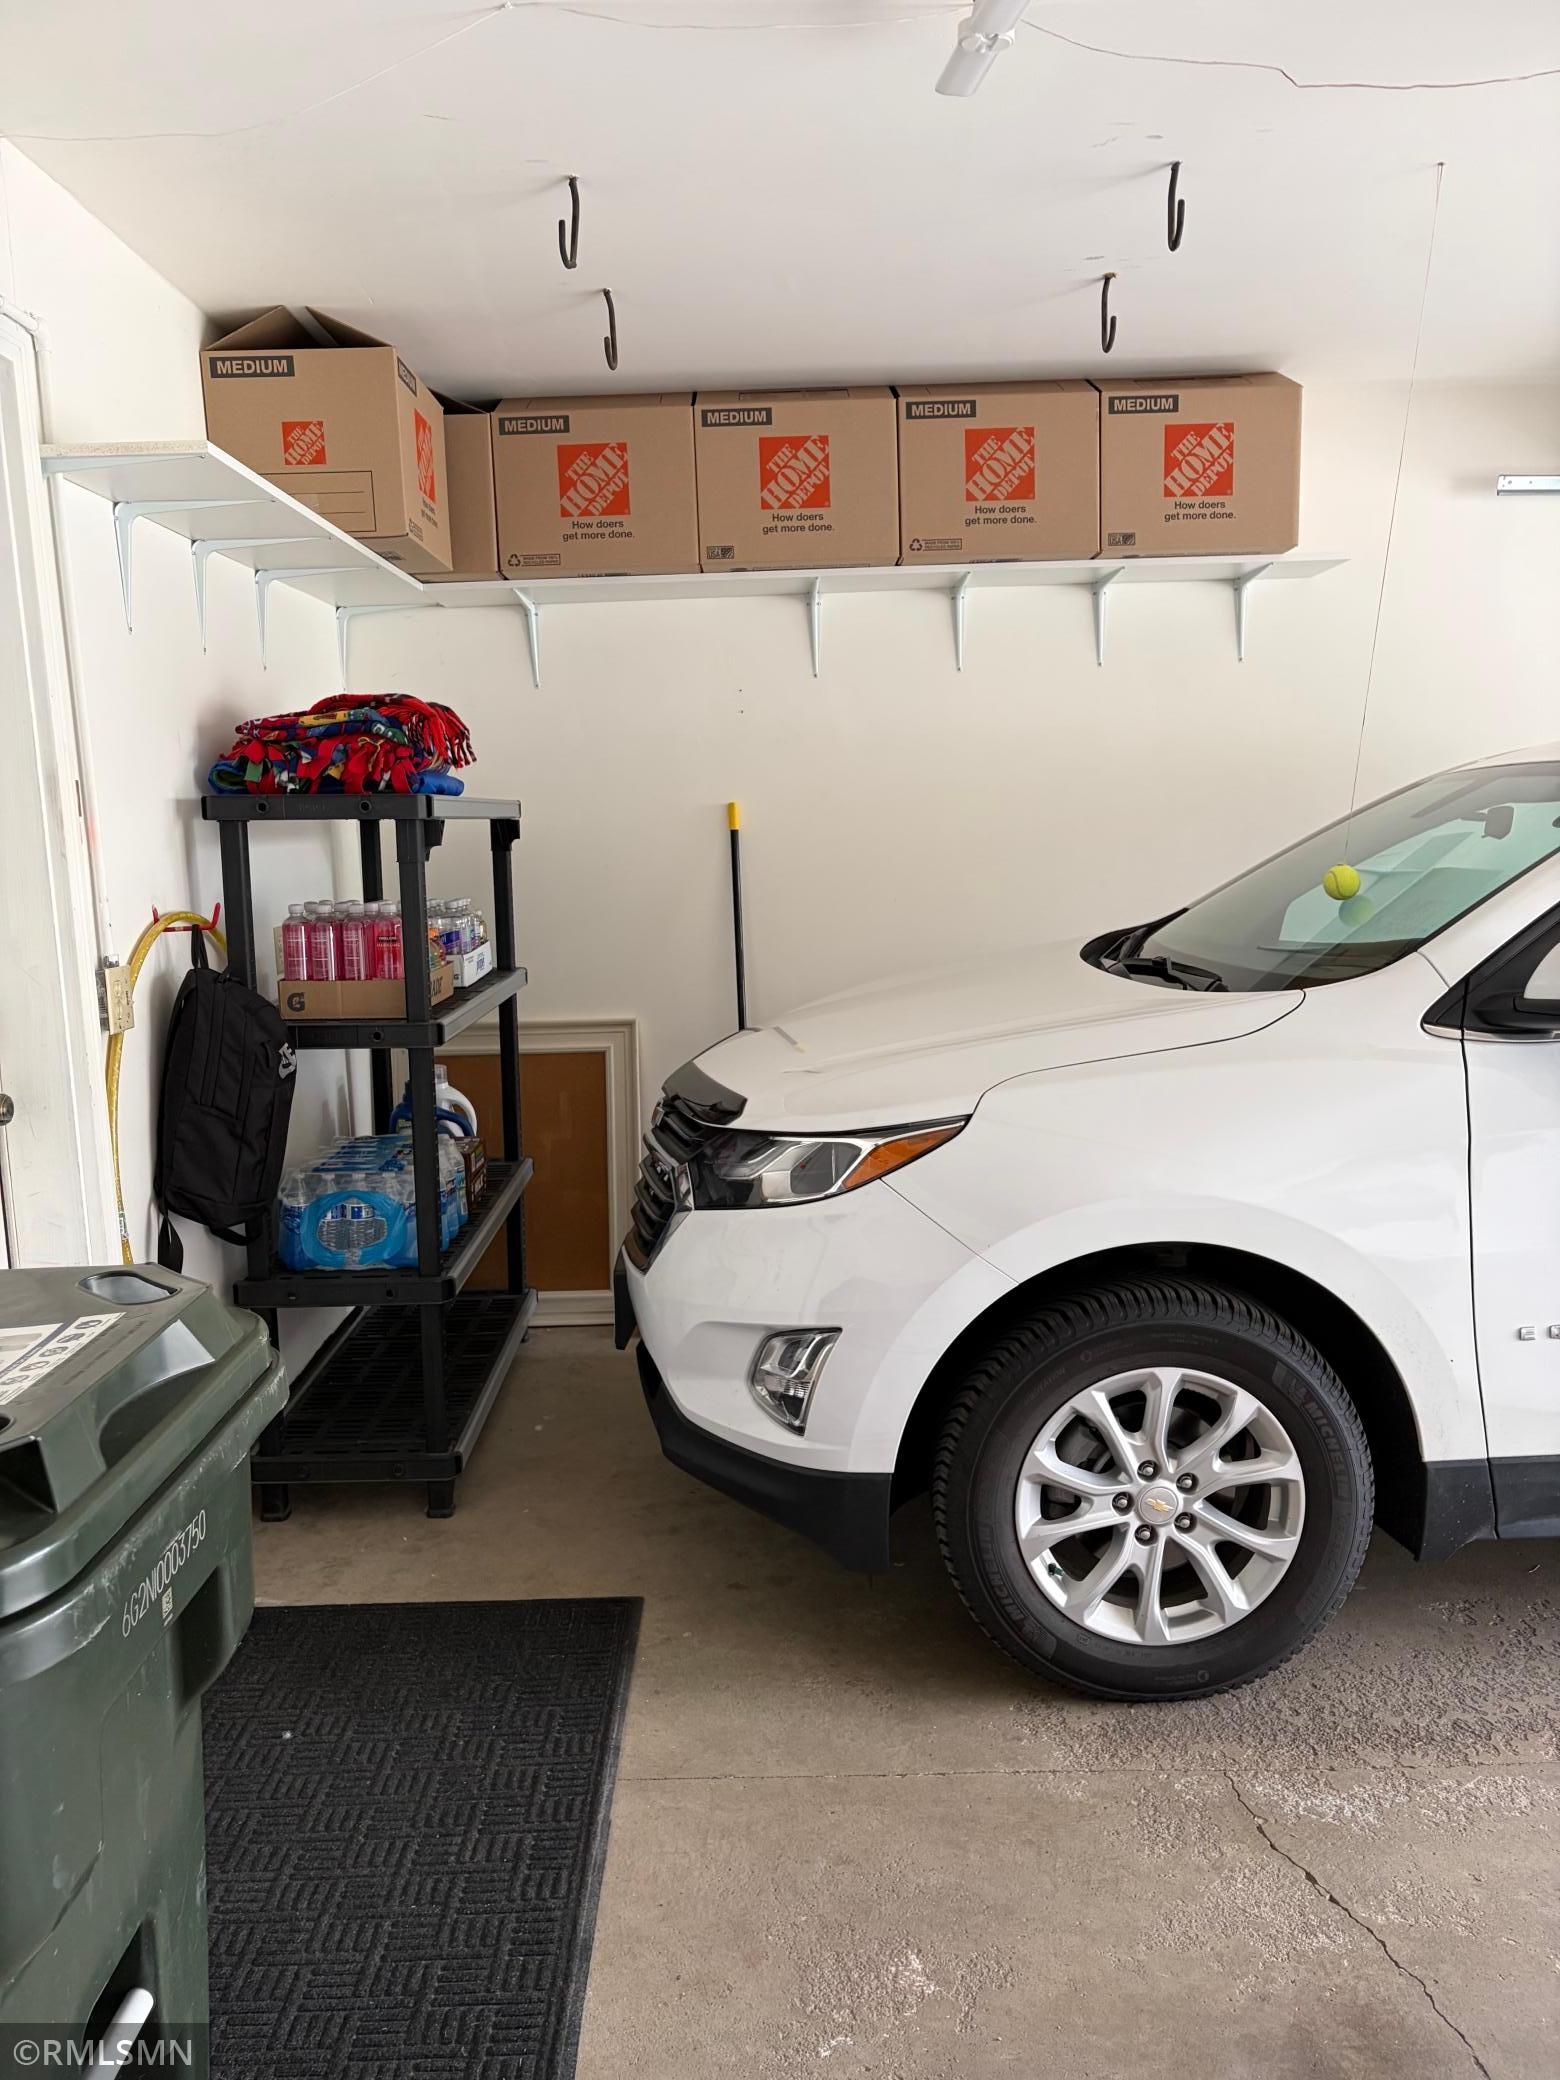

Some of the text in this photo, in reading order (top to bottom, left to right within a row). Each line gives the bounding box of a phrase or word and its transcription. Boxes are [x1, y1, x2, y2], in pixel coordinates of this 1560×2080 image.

[216, 359, 288, 374] MEDIUM
[911, 403, 971, 417] MEDIUM
[1114, 398, 1173, 411] MEDIUM
[504, 418, 564, 432] MEDIUM
[707, 411, 767, 424] MEDIUM
[285, 421, 324, 465] HOME
[287, 425, 304, 444] THE
[1171, 431, 1200, 461] THE
[301, 438, 325, 465] DEPOT
[767, 443, 796, 473] THE
[972, 435, 1001, 466] THE
[1164, 423, 1233, 497] HOME
[564, 451, 594, 480] THE
[761, 435, 829, 509] HOME
[966, 427, 1034, 501] HOME
[1191, 449, 1233, 496] DEPOT
[560, 442, 627, 517] HOME
[787, 461, 830, 509] DEPOT
[993, 454, 1035, 500] DEPOT
[587, 469, 628, 516] DEPOT
[975, 504, 1026, 514] How doers
[1164, 511, 1236, 522] get more done.
[1174, 500, 1226, 510] How doers
[572, 520, 624, 529] How doers
[772, 512, 824, 522] How doers
[965, 517, 981, 527] get
[1010, 515, 1037, 524] done.
[562, 530, 635, 542] get more done.
[762, 523, 835, 535] get more done.
